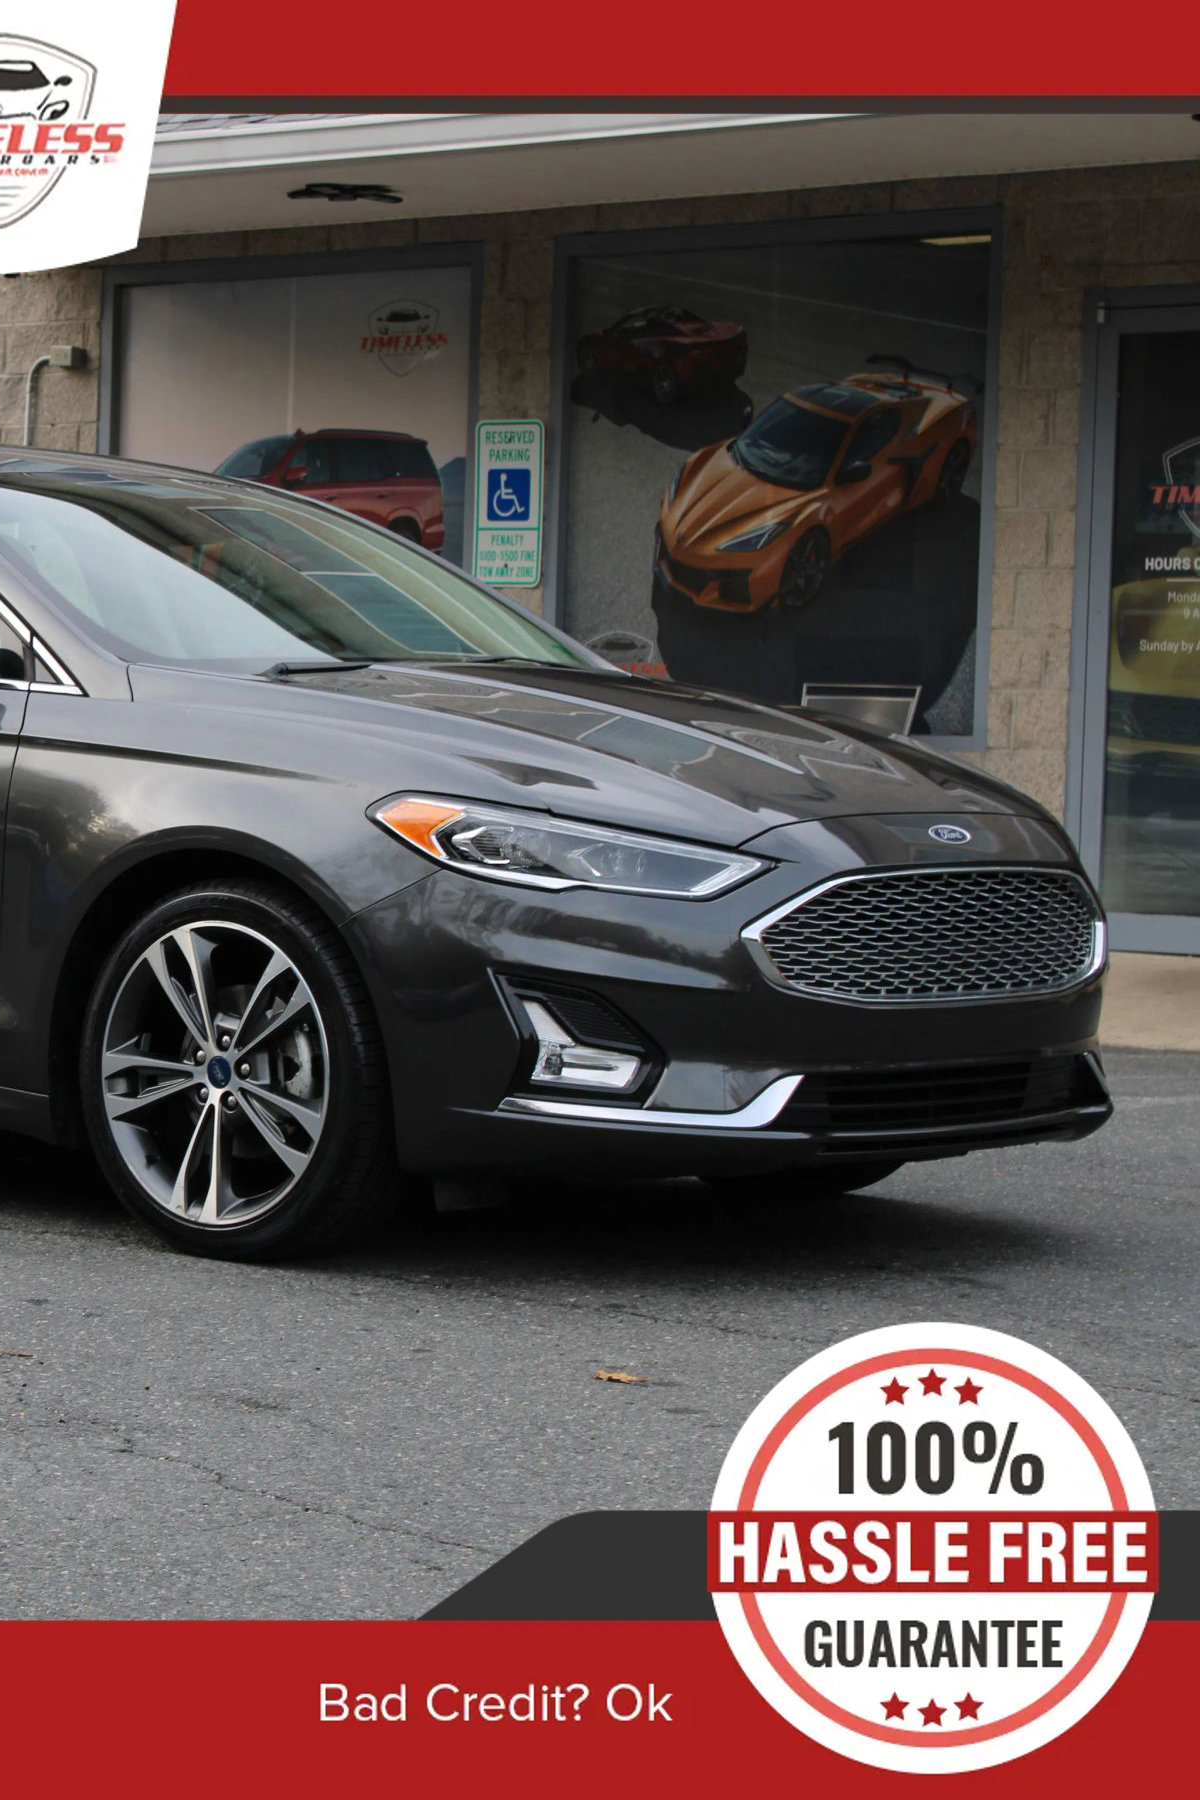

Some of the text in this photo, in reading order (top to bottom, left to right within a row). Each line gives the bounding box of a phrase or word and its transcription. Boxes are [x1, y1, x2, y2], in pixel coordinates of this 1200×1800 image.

[360, 333, 448, 350] TIMELESS
[485, 430, 535, 444] RESERVED
[489, 448, 530, 461] PARKING
[490, 534, 524, 546] PENALTY
[520, 550, 535, 561] FINE
[1145, 557, 1191, 571] HOURS
[479, 566, 494, 577] TOW
[516, 566, 534, 578] ZONE
[1139, 639, 1178, 653] Sunday
[1181, 640, 1194, 653] by
